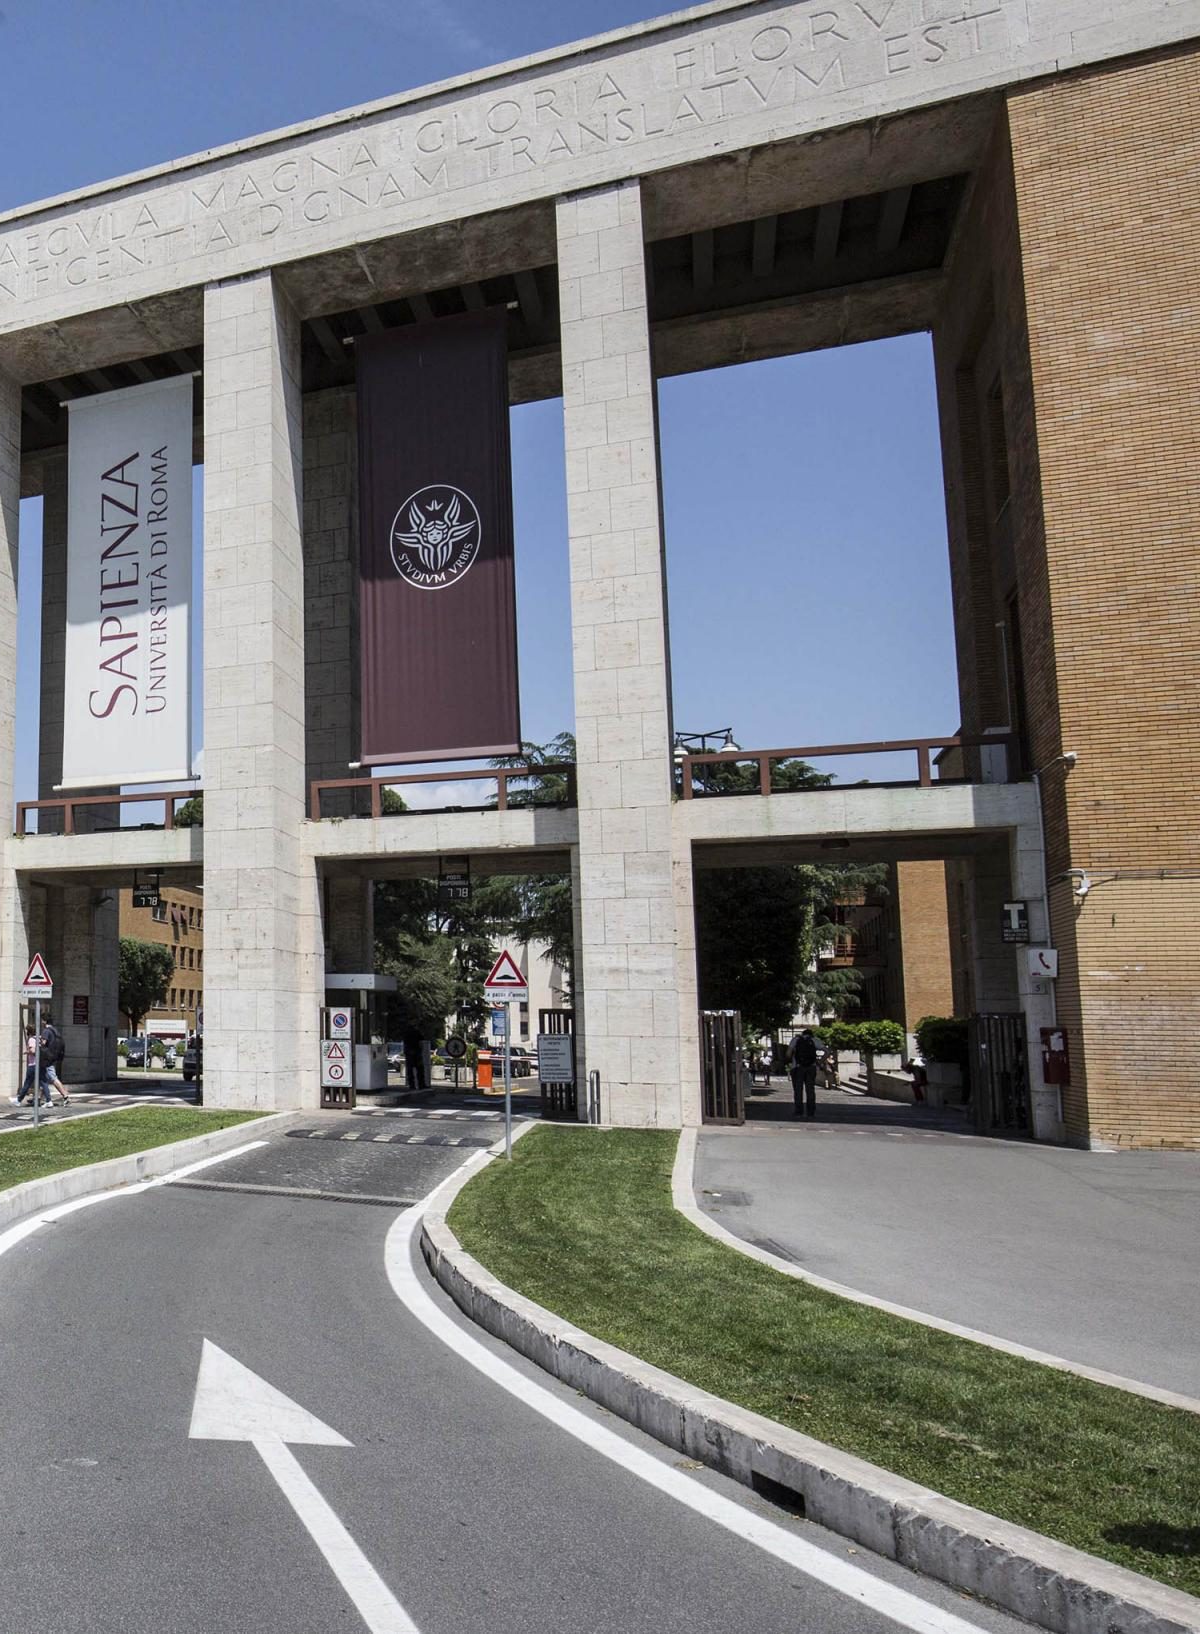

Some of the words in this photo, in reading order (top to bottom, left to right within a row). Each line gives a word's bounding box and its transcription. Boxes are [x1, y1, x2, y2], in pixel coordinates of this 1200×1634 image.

[190, 143, 378, 215] MAGNA
[415, 72, 627, 153] GLORIA
[259, 158, 450, 237] DIGNAM
[473, 53, 847, 177] TRANSLATVM
[884, 8, 1002, 74] EST
[147, 445, 168, 526] ROMA
[151, 531, 168, 559] DI
[398, 553, 446, 583] STVDIVM
[448, 543, 474, 574] VRBIS
